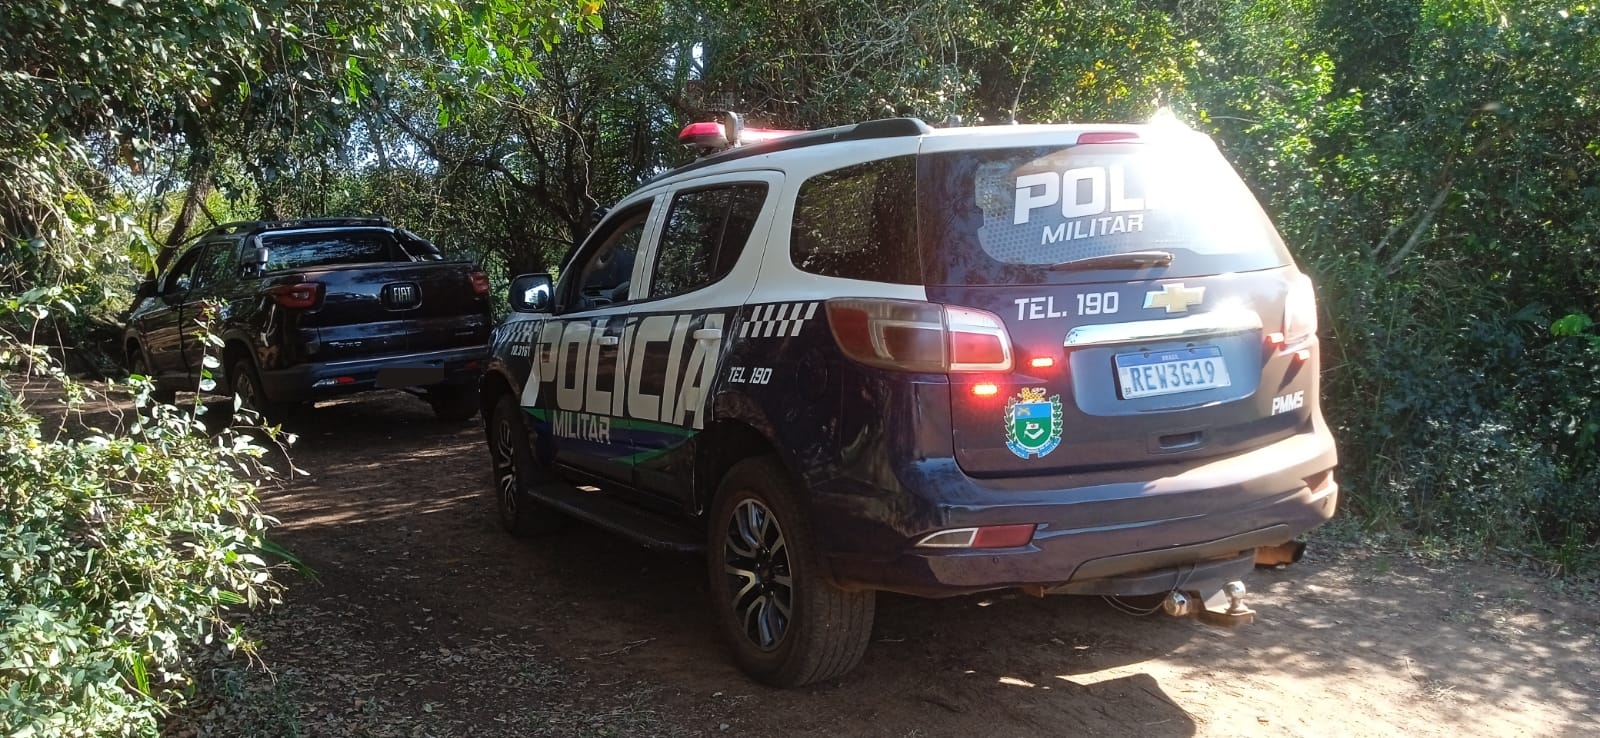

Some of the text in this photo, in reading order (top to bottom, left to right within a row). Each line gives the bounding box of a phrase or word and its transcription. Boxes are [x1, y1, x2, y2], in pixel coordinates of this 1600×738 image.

[1041, 213, 1144, 245] MILITAR
[393, 286, 412, 302] FIAT
[1014, 291, 1119, 321] TEL. 190
[749, 367, 773, 385] 190
[1129, 360, 1216, 392] REW3G19
[1271, 390, 1305, 416] PMMS
[552, 409, 611, 445] MILITAR
